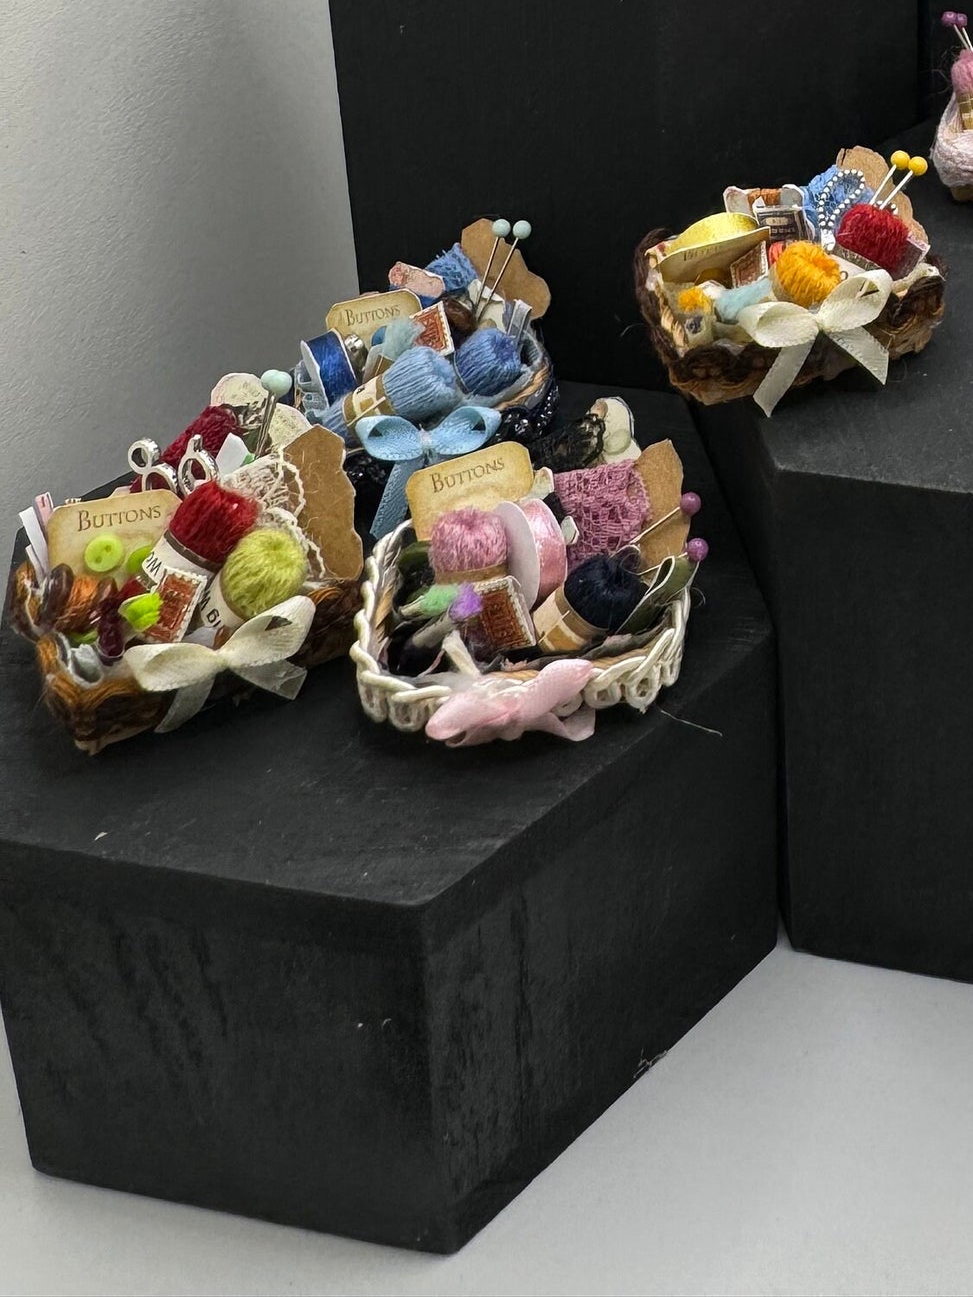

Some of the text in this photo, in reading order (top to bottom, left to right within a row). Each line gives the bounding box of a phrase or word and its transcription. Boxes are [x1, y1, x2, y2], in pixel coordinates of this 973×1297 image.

[345, 305, 400, 326] BUTTONS
[431, 458, 505, 493] BUTTONS
[77, 505, 161, 531] BUTTONS
